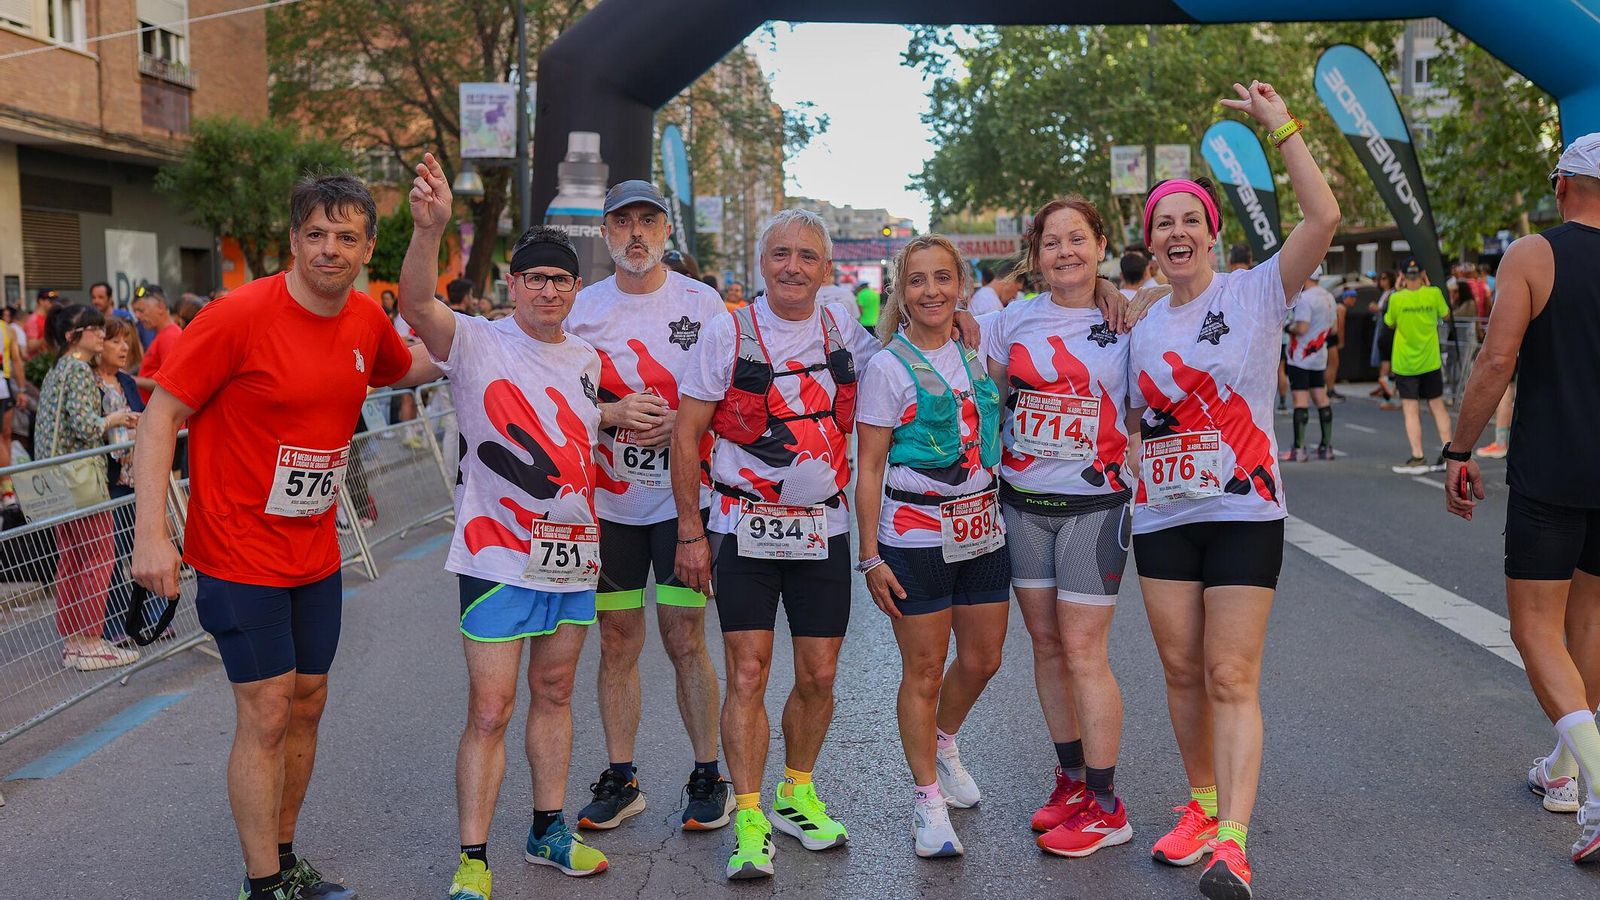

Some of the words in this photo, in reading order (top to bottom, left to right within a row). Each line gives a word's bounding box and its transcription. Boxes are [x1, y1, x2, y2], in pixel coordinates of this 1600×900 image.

[618, 429, 631, 443] 41
[1016, 410, 1083, 441] 1714
[281, 450, 298, 466] 41
[623, 446, 670, 470] 621
[1146, 442, 1156, 457] 41
[1152, 454, 1196, 485] 876
[285, 470, 334, 497] 576
[534, 523, 545, 538] 41
[750, 516, 804, 540] 934
[953, 511, 990, 543] 989
[541, 541, 582, 567] 751
